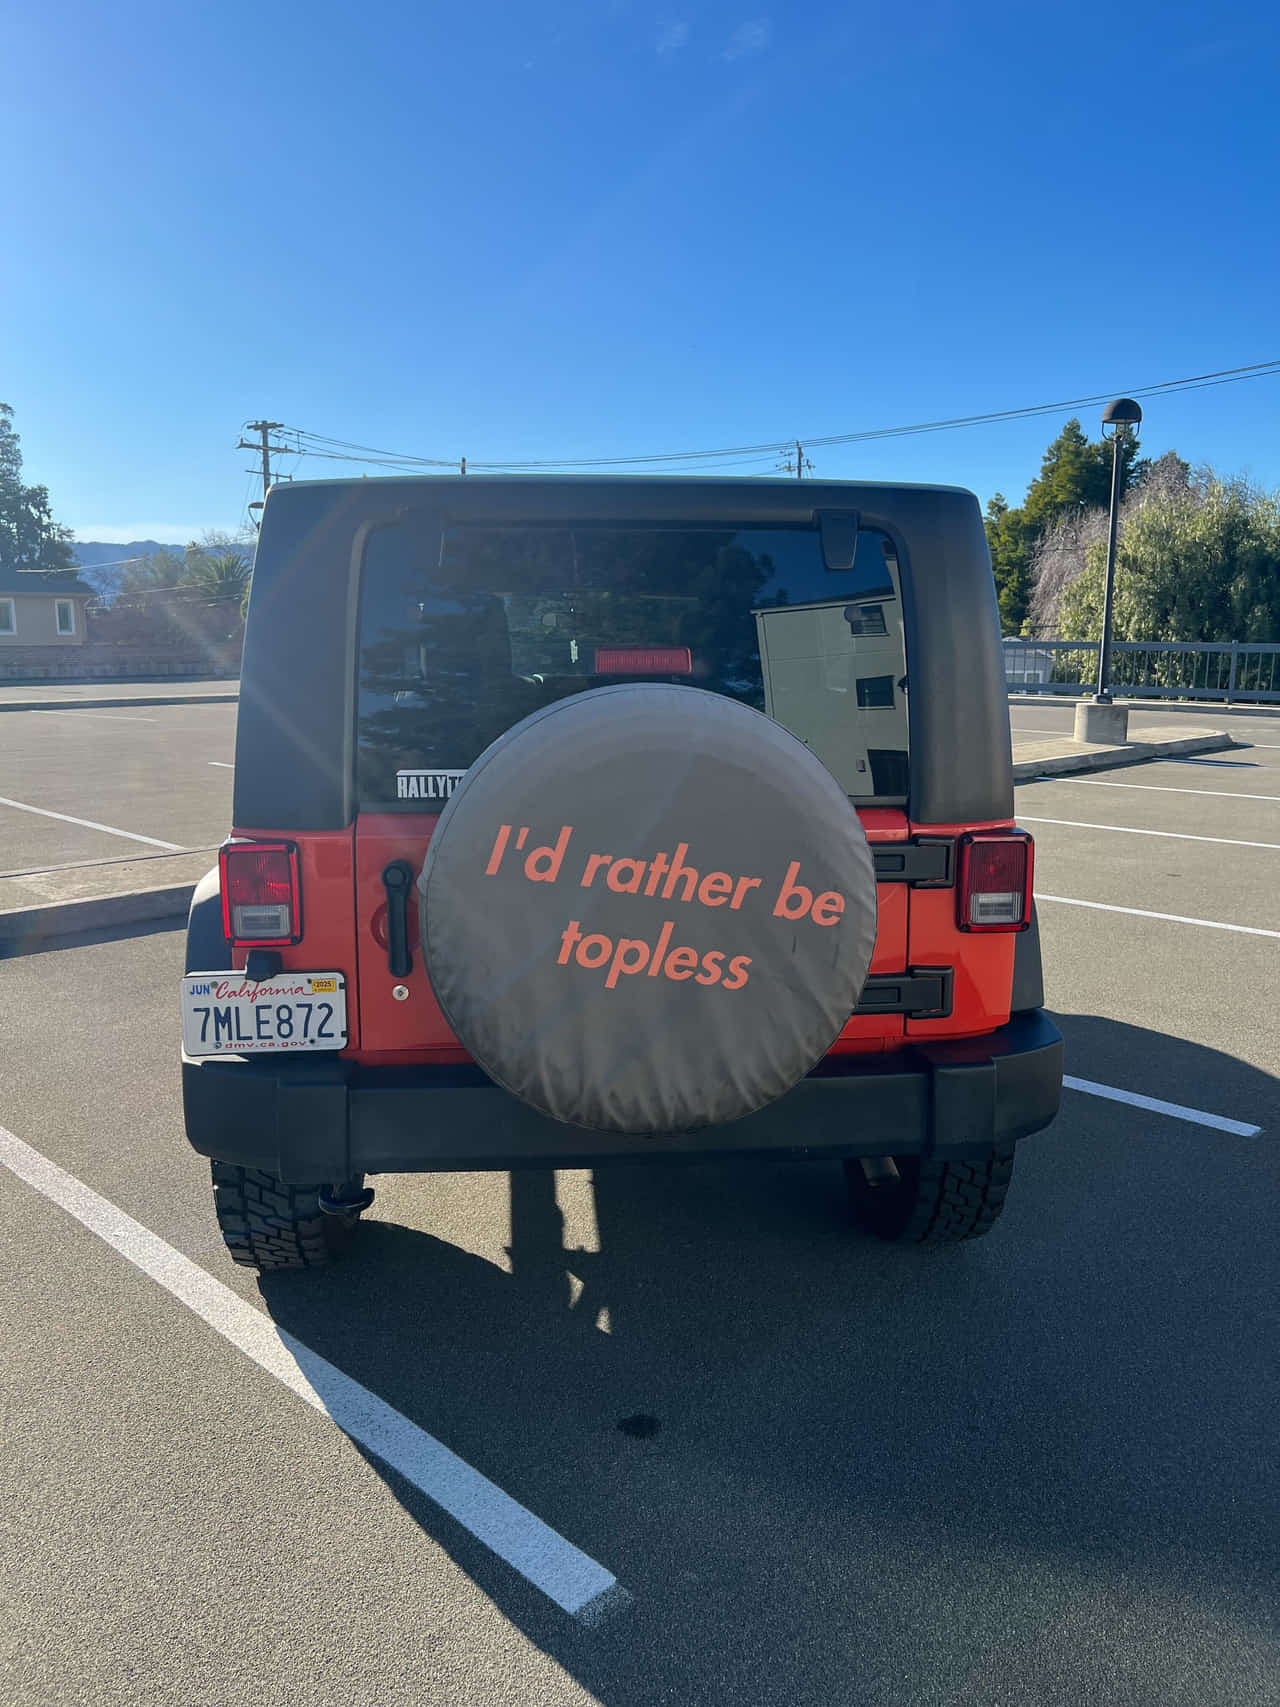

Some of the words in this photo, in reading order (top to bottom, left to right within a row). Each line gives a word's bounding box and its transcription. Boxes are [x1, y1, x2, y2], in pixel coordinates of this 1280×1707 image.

[485, 824, 573, 883] I'd
[580, 843, 761, 910] rather
[772, 861, 845, 926] be
[557, 921, 752, 990] topless
[189, 985, 210, 996] JUN
[215, 981, 314, 1004] California
[193, 1003, 334, 1042] 7MLE872
[225, 1041, 307, 1049] dmv.ca.gov
